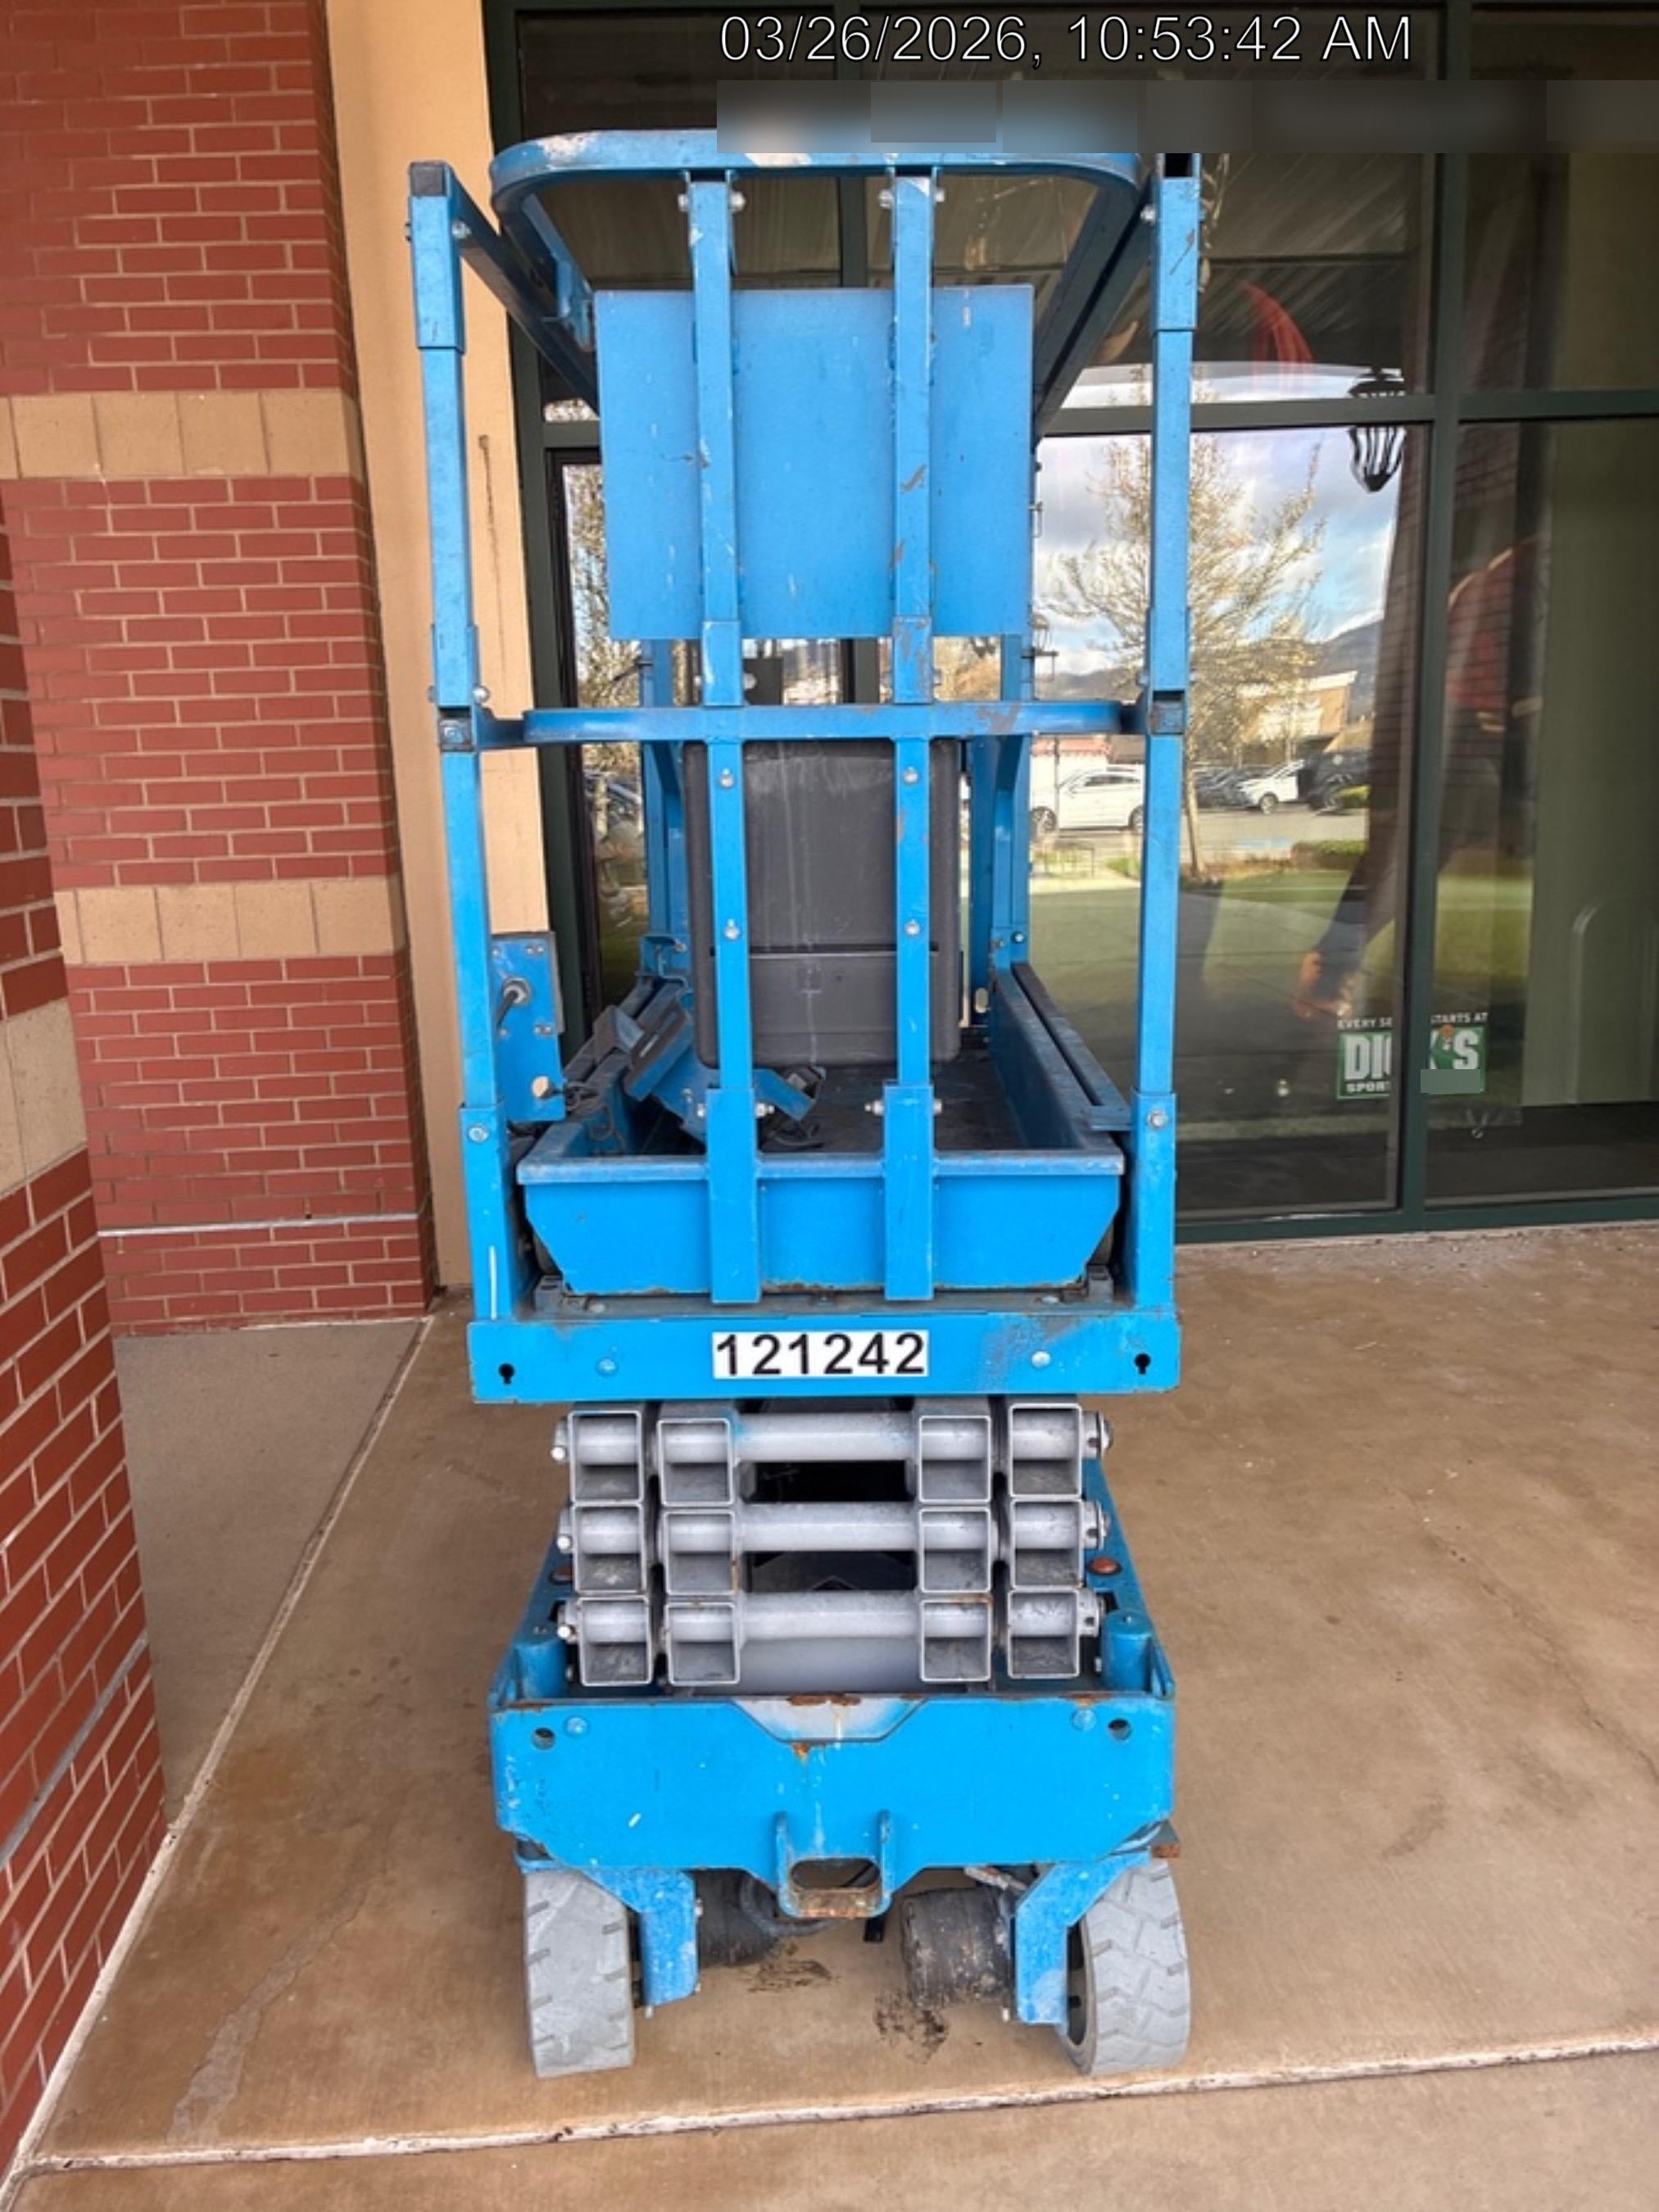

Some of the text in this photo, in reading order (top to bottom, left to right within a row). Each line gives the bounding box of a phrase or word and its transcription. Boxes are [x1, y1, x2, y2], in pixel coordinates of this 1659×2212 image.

[1337, 1019, 1376, 1028] EVERY
[1475, 1011, 1489, 1022] AT
[717, 1332, 924, 1376] 121242
